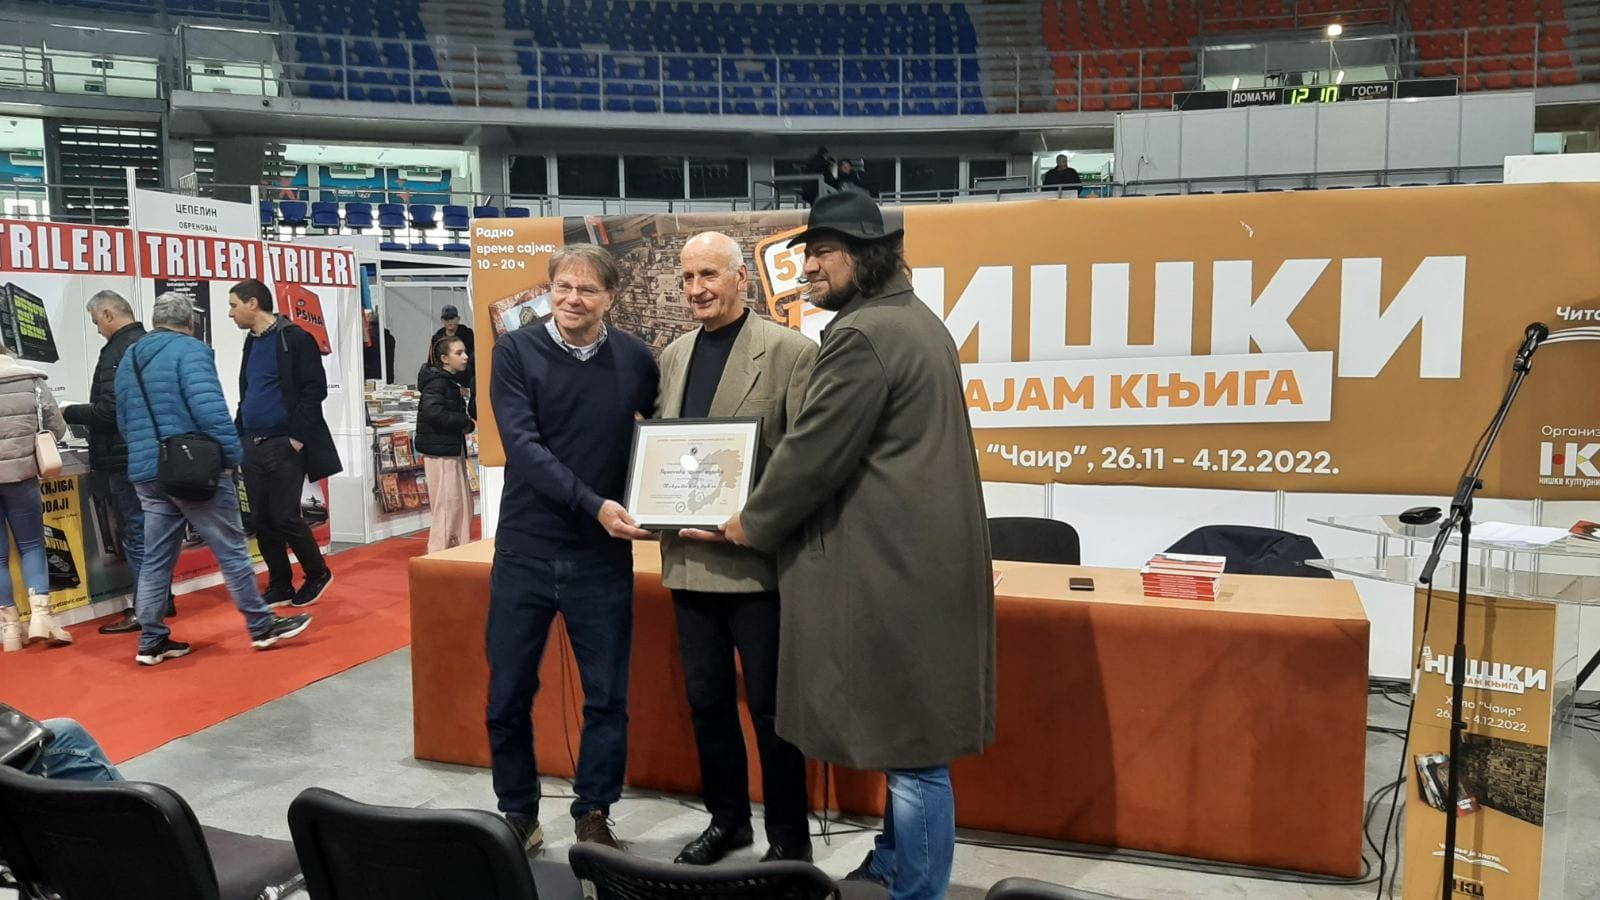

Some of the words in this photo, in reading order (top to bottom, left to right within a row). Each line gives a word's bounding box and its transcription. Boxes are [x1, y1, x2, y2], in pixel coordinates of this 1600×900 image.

[1233, 91, 1276, 104] ДОМАЋИ
[1291, 88, 1309, 104] 12
[1352, 86, 1387, 97] ГОСТИ
[175, 203, 217, 218] ЦЕПЕЛИН
[178, 221, 218, 233] ОБРЕНОВАЦ
[476, 227, 514, 239] Радно
[476, 245, 514, 256] време
[517, 242, 556, 256] сајма:
[146, 235, 257, 279] TRILERI
[477, 259, 490, 270] 10
[500, 259, 515, 270] 20
[517, 261, 525, 270] ч
[268, 246, 356, 286] TRILERI
[295, 307, 323, 326] PSIHA
[911, 255, 1467, 379] ИШКИ
[964, 375, 1095, 413] АЈАМ
[1109, 369, 1304, 409] КЊИГА
[1101, 446, 1164, 470] 26.11
[1192, 448, 1340, 475] 4.12.2022.
[1445, 696, 1476, 709] Хла
